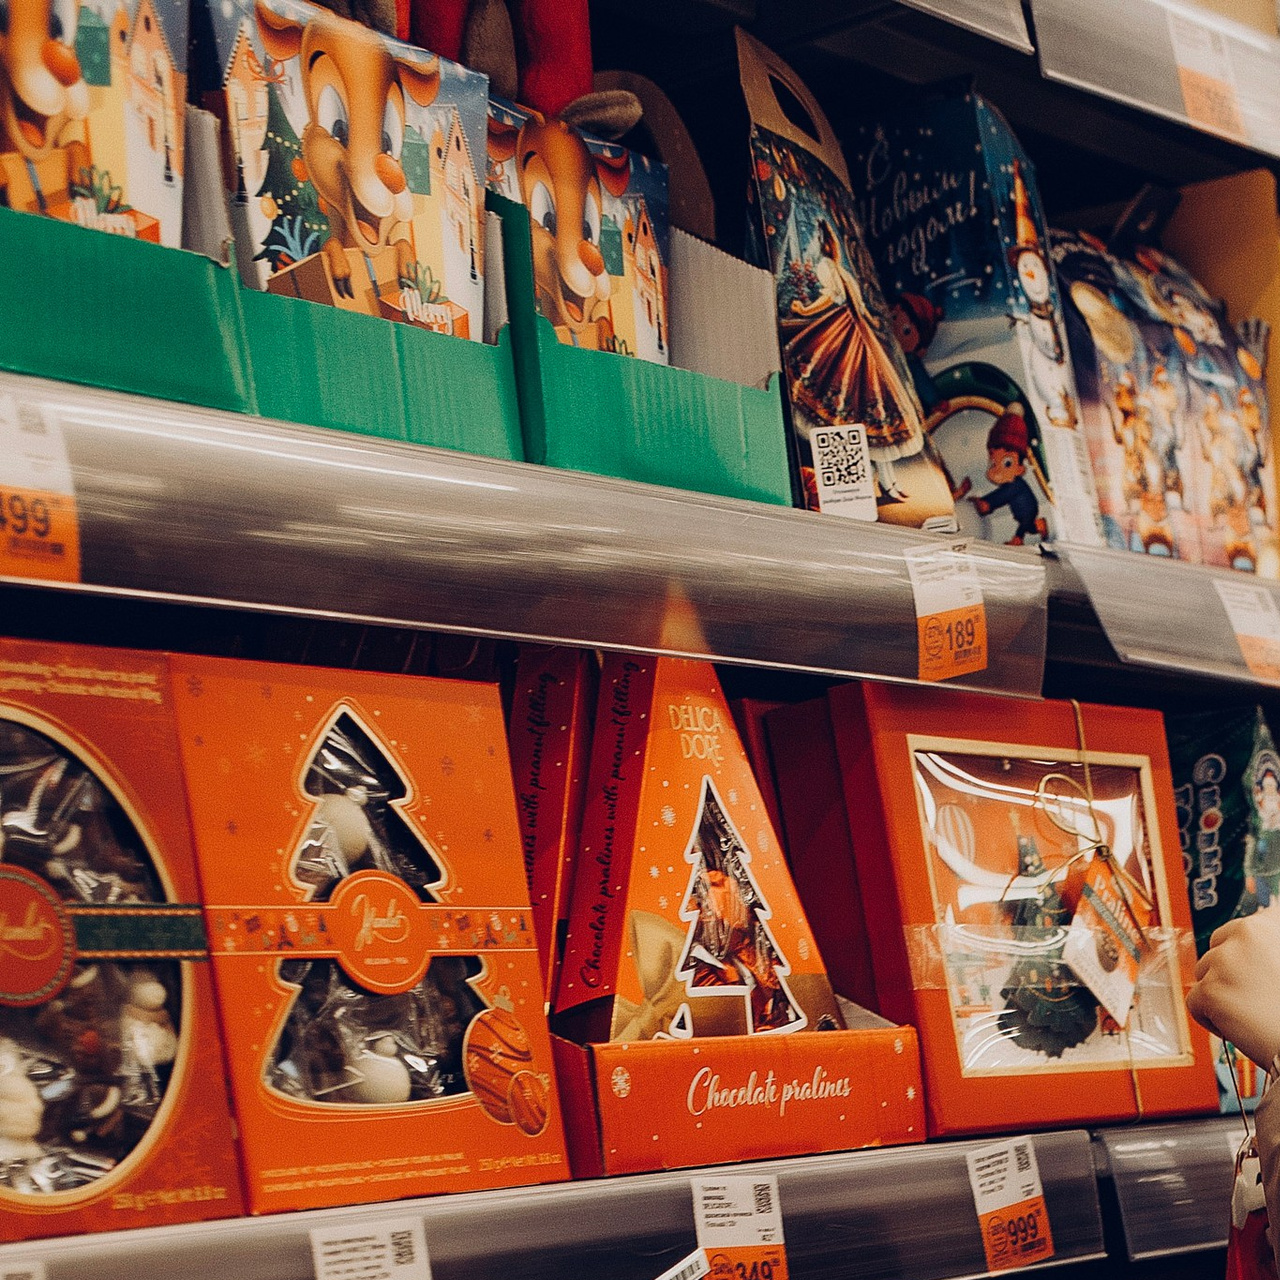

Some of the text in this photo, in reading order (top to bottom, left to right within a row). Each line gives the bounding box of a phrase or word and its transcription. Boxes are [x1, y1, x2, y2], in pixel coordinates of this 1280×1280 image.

[0, 493, 50, 537] 99
[946, 618, 975, 650] 189
[580, 662, 640, 989] Chocolate pralines with peanut filling
[687, 1065, 853, 1117] Chocolate pralines
[1007, 1213, 1039, 1246] 999
